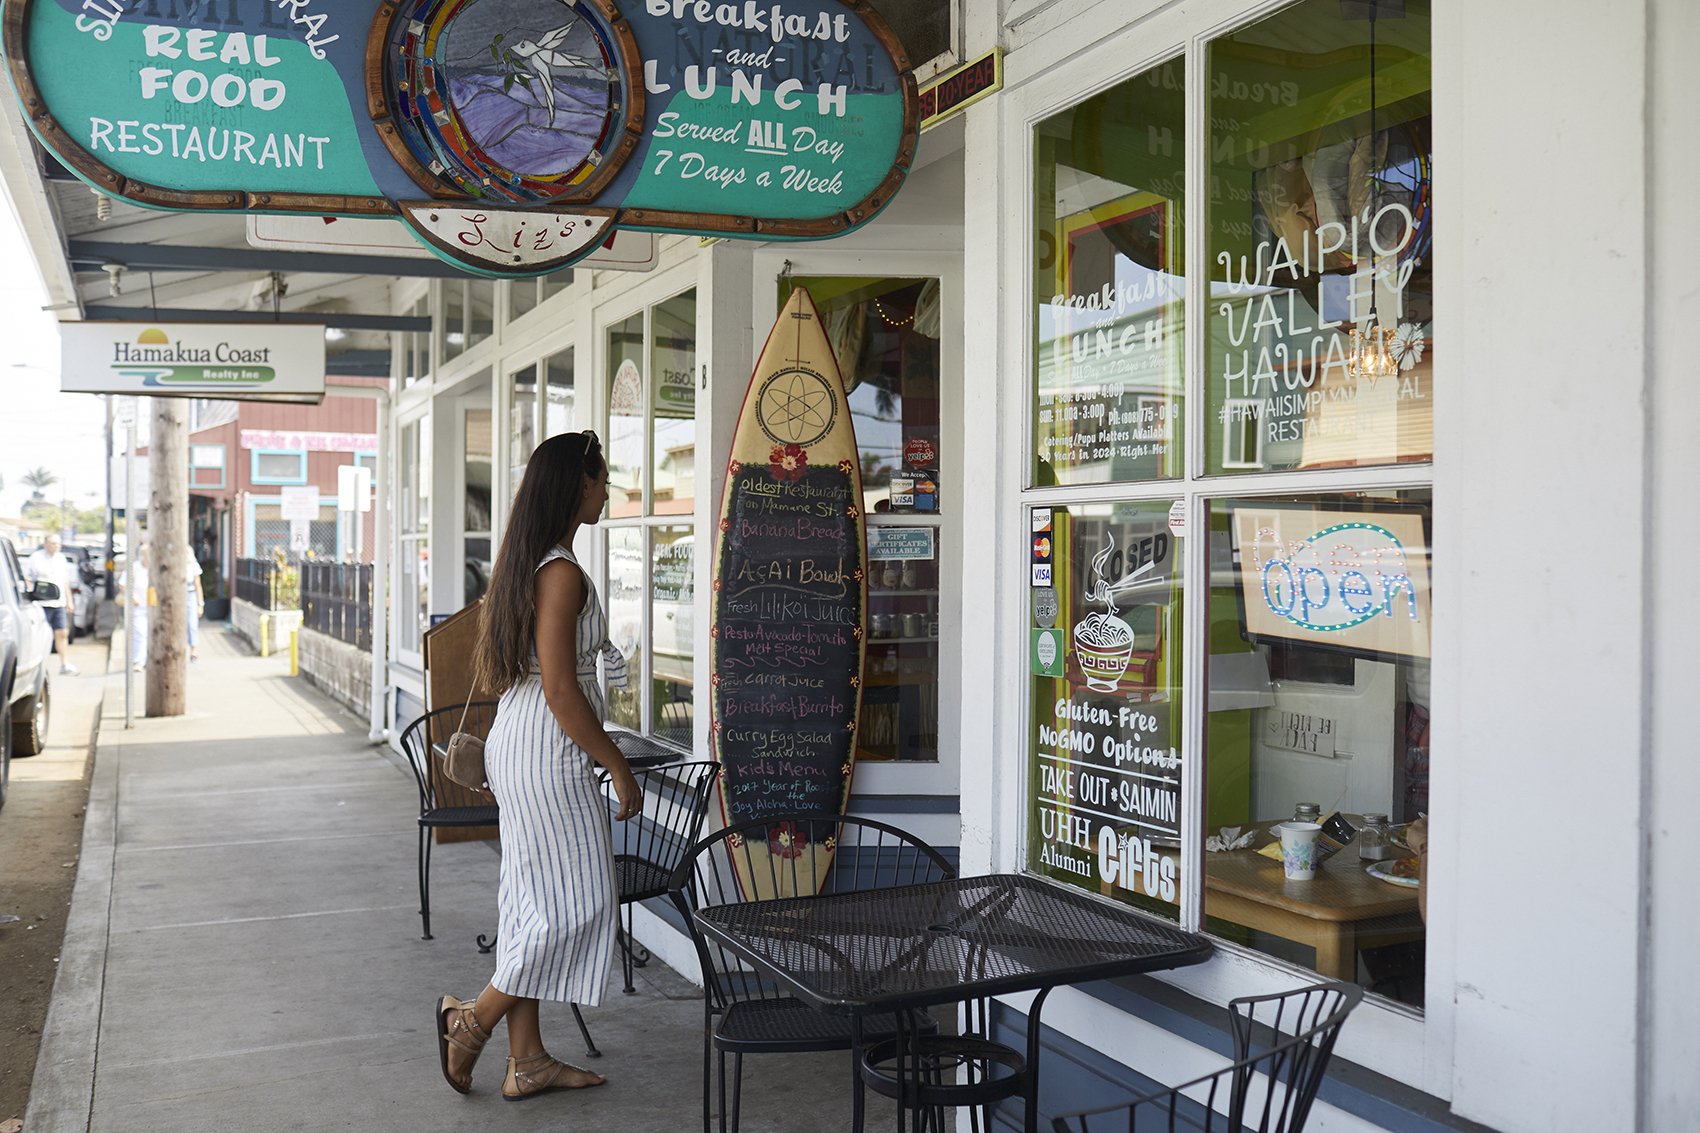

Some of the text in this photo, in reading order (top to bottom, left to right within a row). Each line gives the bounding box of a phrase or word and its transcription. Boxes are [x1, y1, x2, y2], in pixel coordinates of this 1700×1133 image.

[142, 24, 281, 67] REAL
[139, 67, 286, 111] FOOD
[644, 59, 847, 117] LUNCH
[89, 116, 330, 170] RESTAURANT
[652, 111, 743, 145] Served
[747, 119, 787, 150] ALL
[791, 126, 845, 164] Day
[654, 150, 673, 175] 7
[679, 151, 747, 189] Days
[756, 172, 772, 187] a
[780, 165, 844, 195] Week
[1050, 268, 1167, 320] Breakfast
[1219, 259, 1414, 347] VALLEY
[113, 340, 271, 363] Hamakua Coast
[1053, 318, 1163, 366] LUNCH
[202, 369, 260, 381] Realty Inc
[907, 451, 926, 462] yelp
[893, 496, 913, 504] VISA
[742, 517, 847, 541] Banana Bread
[1034, 569, 1050, 580] VISA
[1262, 558, 1418, 621] Open
[727, 600, 758, 614] Fresh
[725, 694, 844, 720] Breakfast Burrito
[1055, 698, 1158, 733] Gluten-Free
[727, 729, 833, 751] Curry Egg Salad
[751, 747, 816, 758] Sandwich
[1102, 733, 1177, 769] Options
[762, 779, 788, 795] Year
[778, 761, 827, 777] Menu
[1040, 764, 1177, 823] TAKE OUT SAIMIN
[1040, 806, 1092, 851] UHH
[1040, 842, 1092, 878] Alumni
